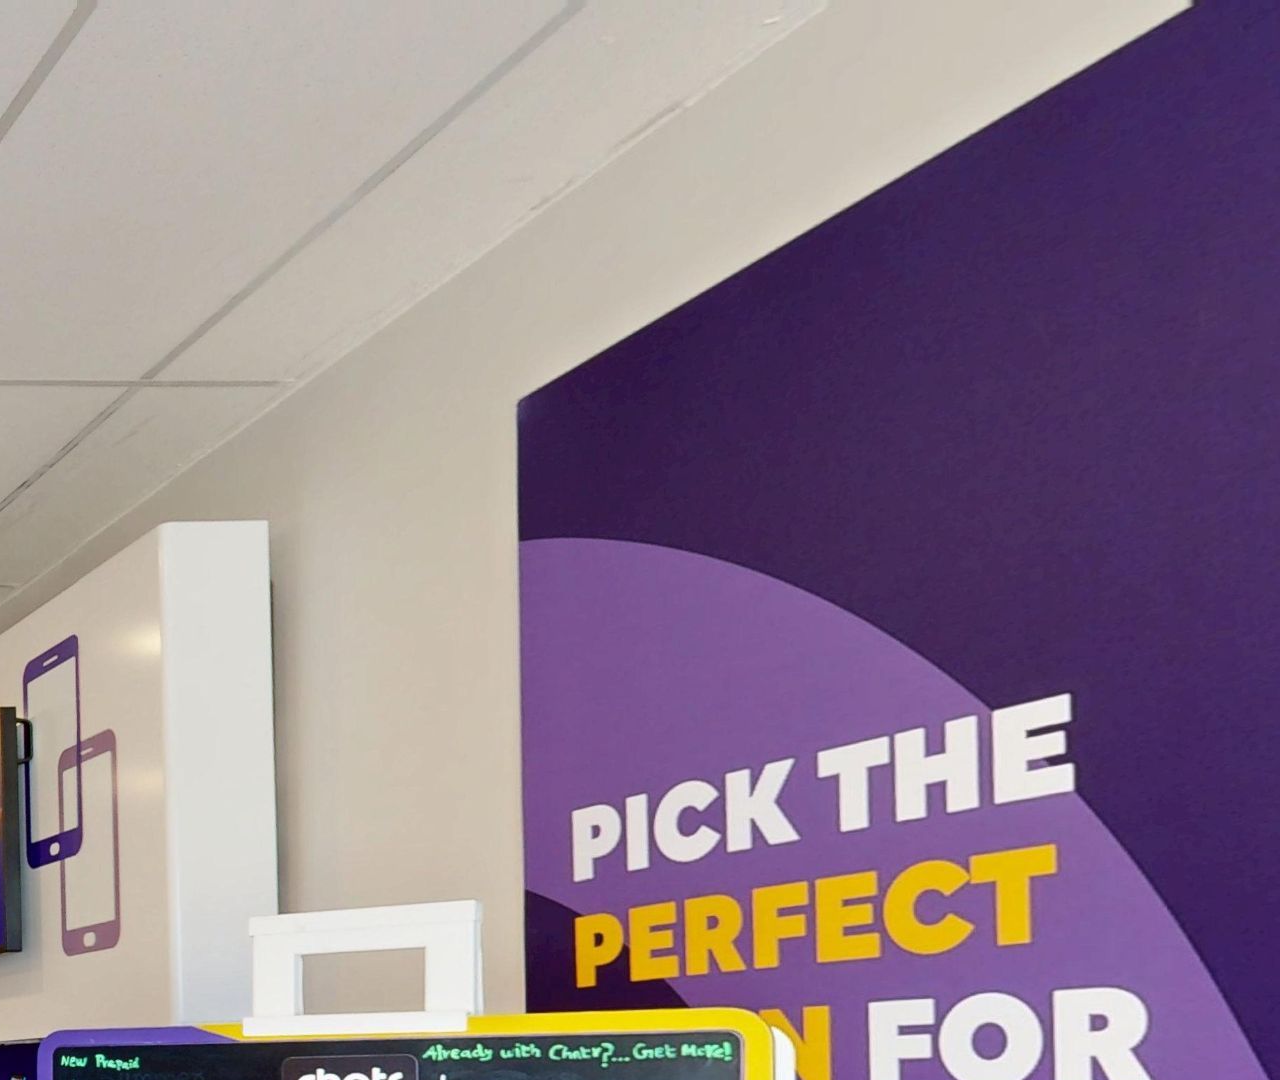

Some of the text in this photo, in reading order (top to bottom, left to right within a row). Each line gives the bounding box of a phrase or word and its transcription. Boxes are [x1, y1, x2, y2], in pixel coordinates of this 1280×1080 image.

[572, 693, 1075, 882] PICK THE
[575, 844, 1057, 988] PERFECT
[95, 1053, 140, 1071] Prepaid
[422, 1043, 494, 1062] Already
[500, 1042, 542, 1059] with
